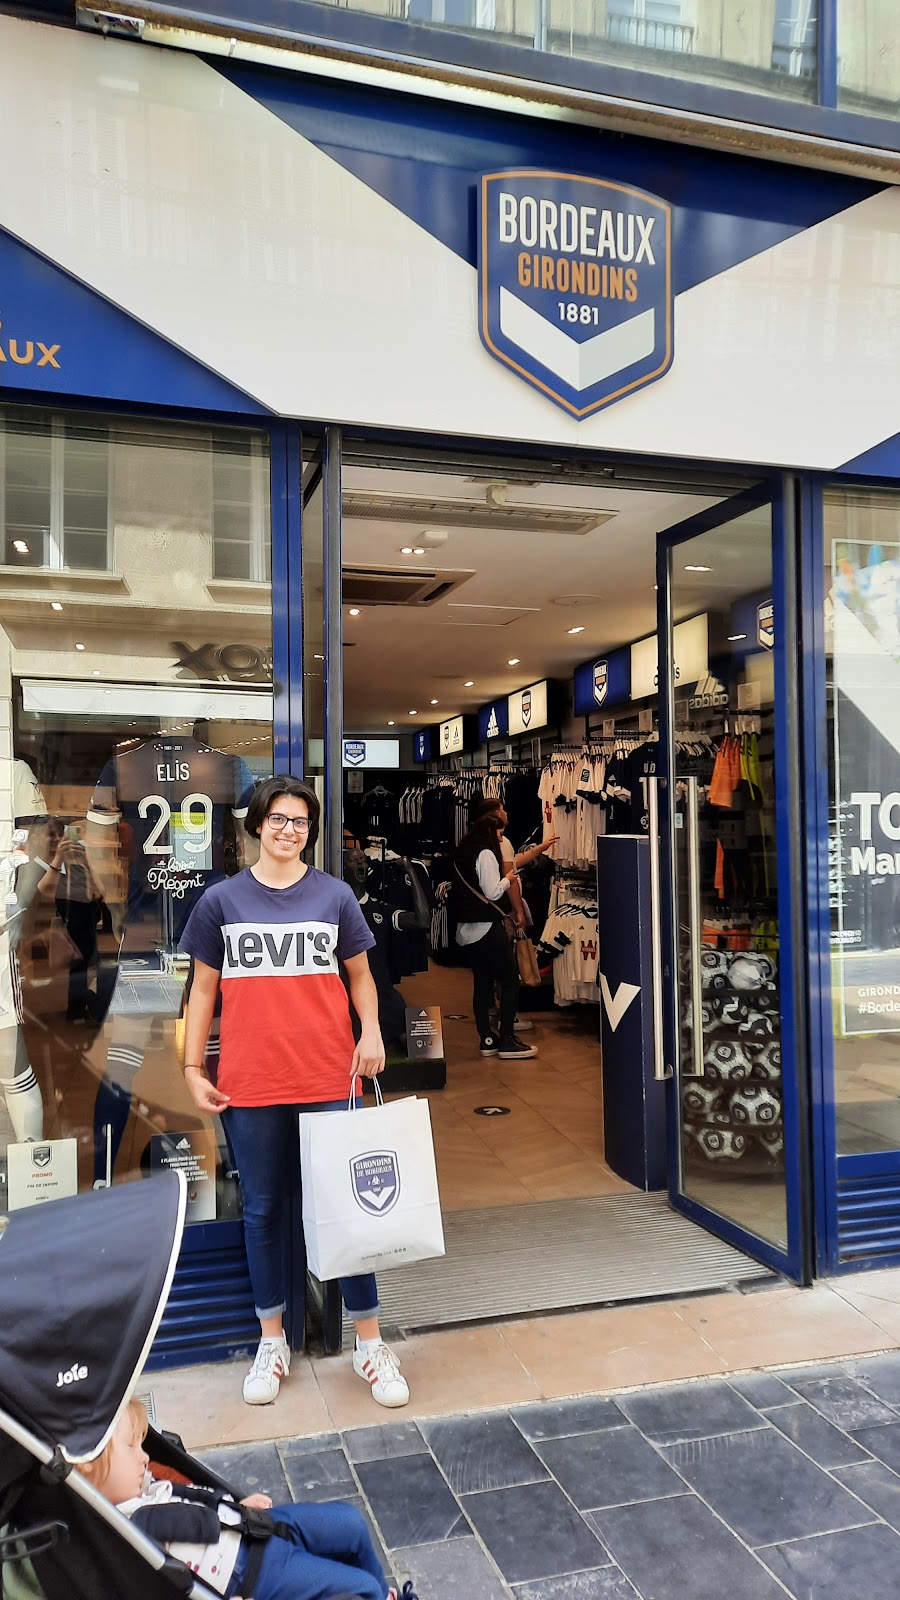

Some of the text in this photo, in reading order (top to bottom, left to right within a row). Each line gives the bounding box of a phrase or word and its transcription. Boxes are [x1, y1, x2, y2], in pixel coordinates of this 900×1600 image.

[500, 193, 655, 265] BORDEAUX
[518, 252, 637, 302] GIRONDINS
[558, 302, 599, 325] 1881
[138, 793, 213, 855] 29
[356, 1157, 392, 1170] GIRONDINS
[56, 1363, 88, 1388] Joie
